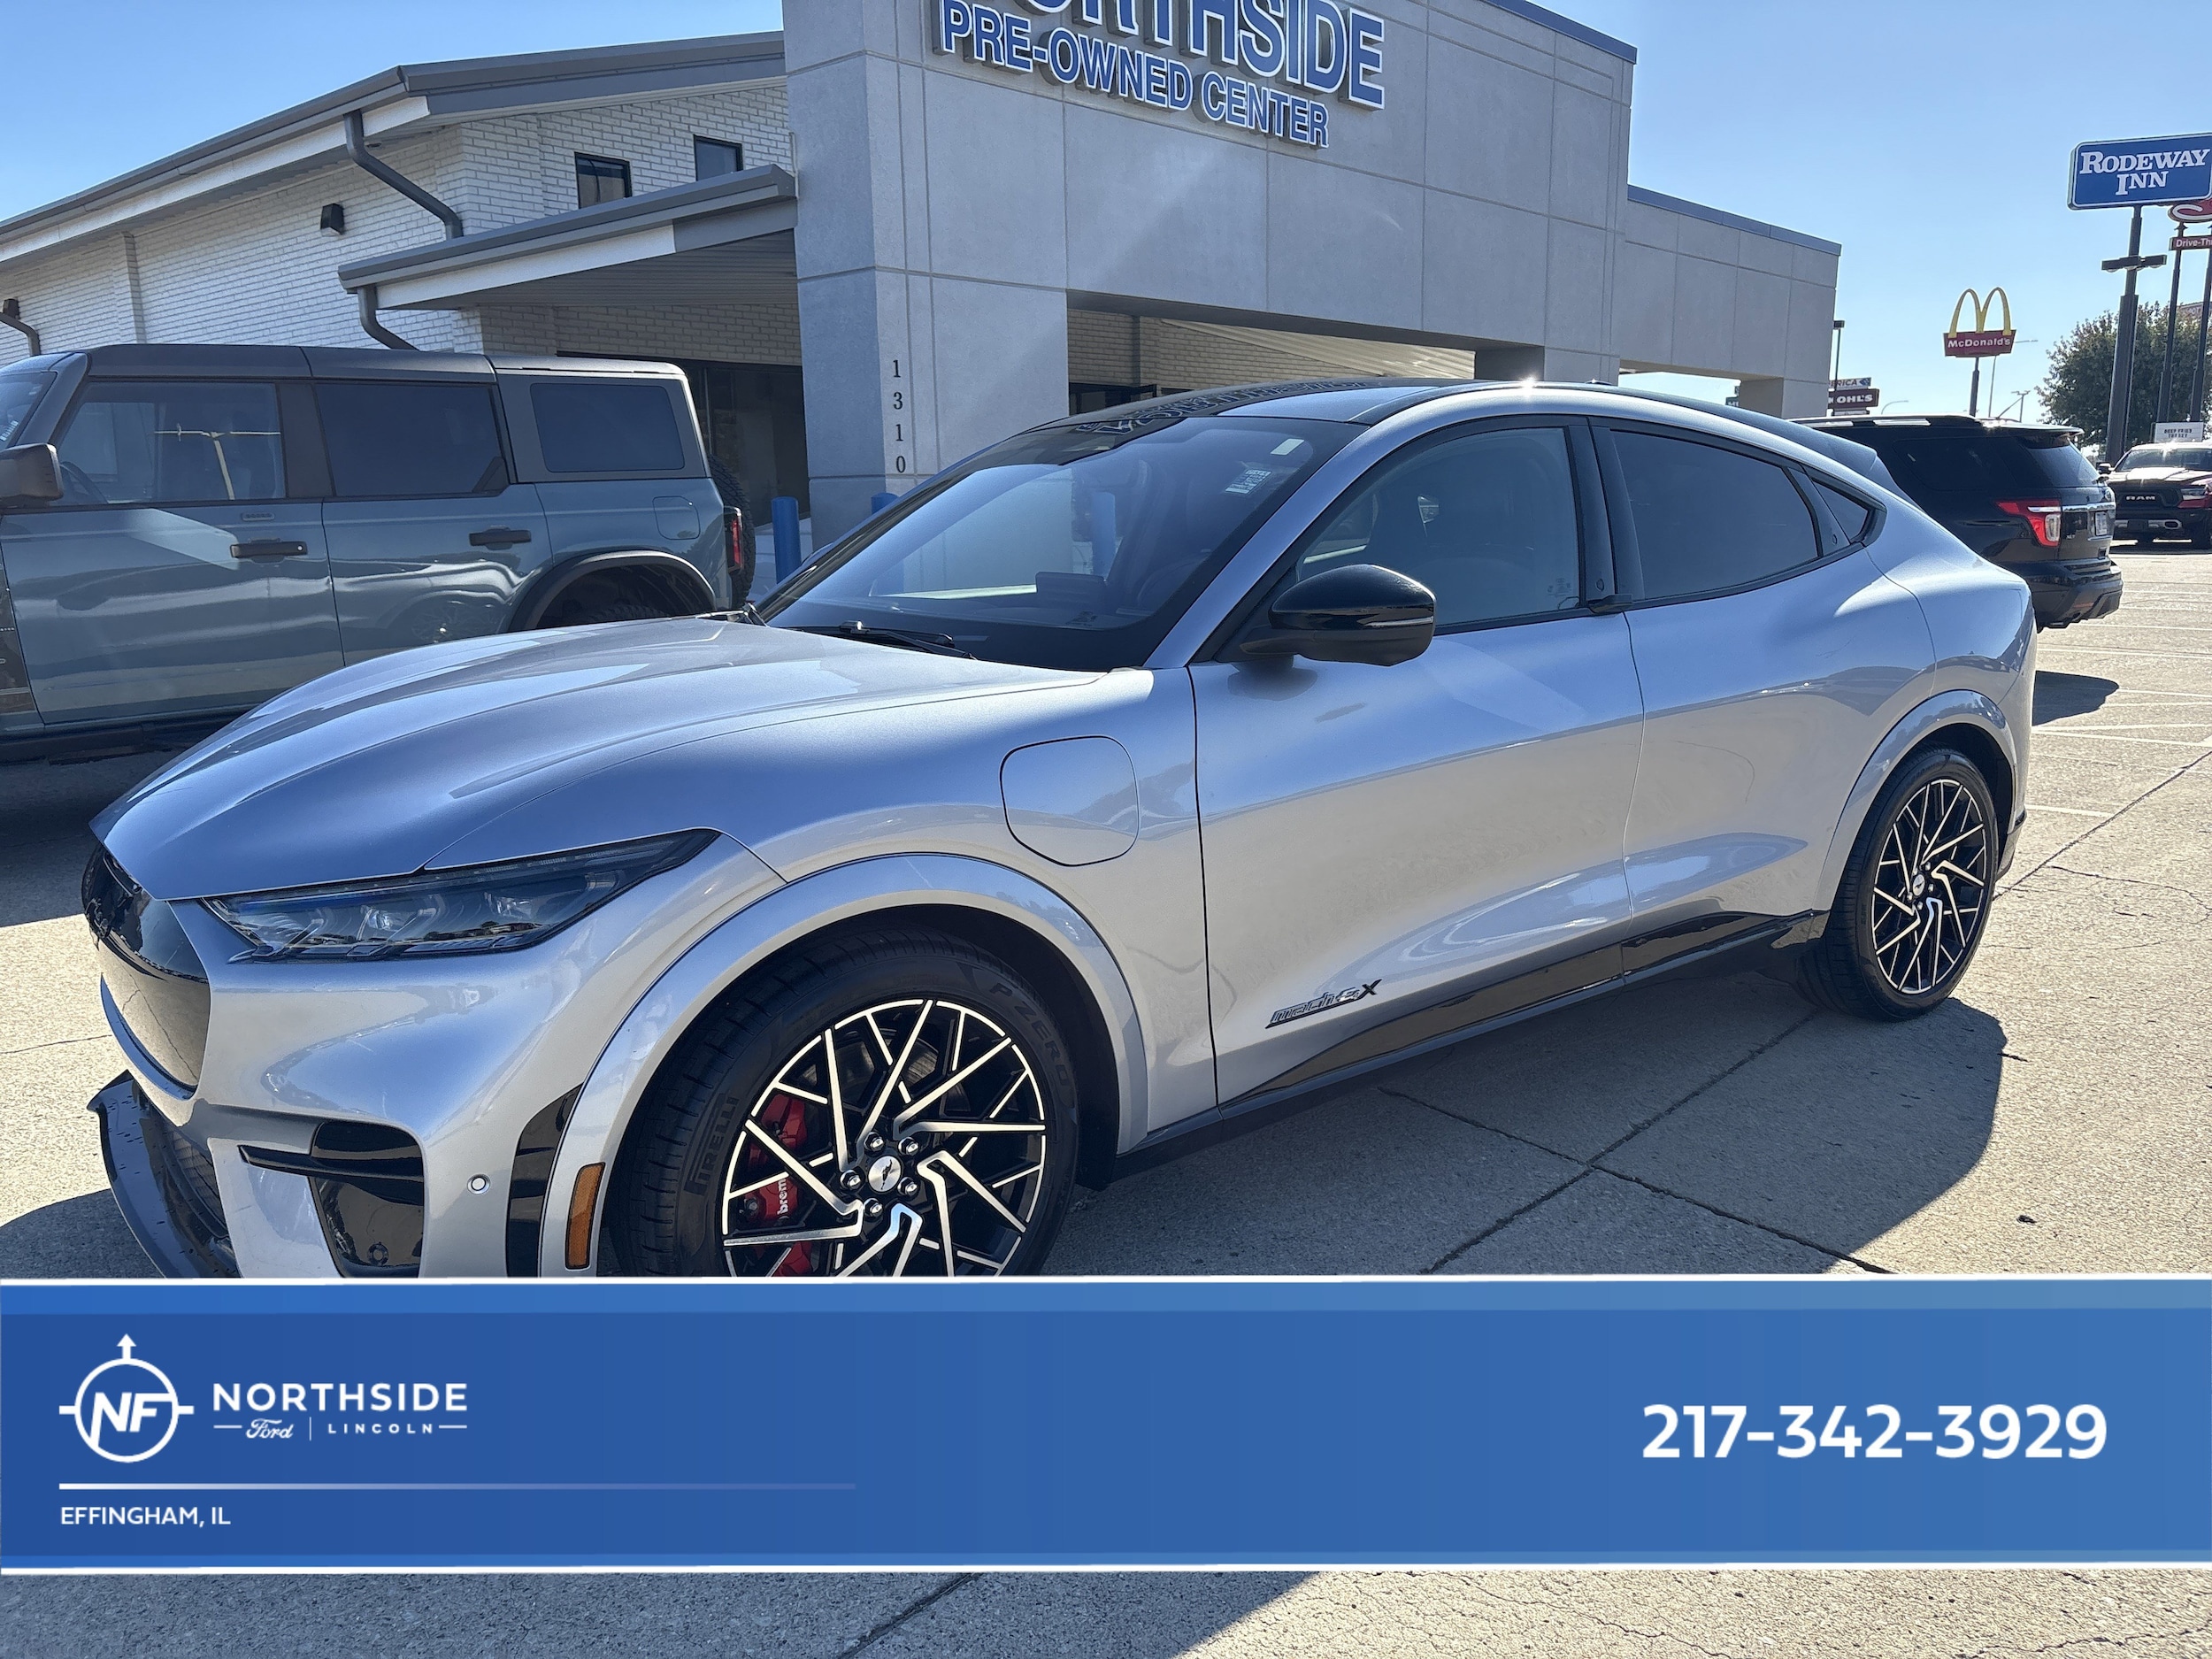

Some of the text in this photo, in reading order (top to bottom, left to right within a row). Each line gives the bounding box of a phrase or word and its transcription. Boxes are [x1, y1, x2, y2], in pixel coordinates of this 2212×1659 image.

[941, 0, 1329, 148] PRE-OWNED CENTER
[2079, 149, 2211, 175] RODEWAY
[2116, 171, 2169, 196] INN
[2176, 238, 2212, 249] Drive-Th
[1947, 337, 2011, 348] McDonald's
[684, 1094, 740, 1196] PIRELLI
[777, 1178, 789, 1215] brem
